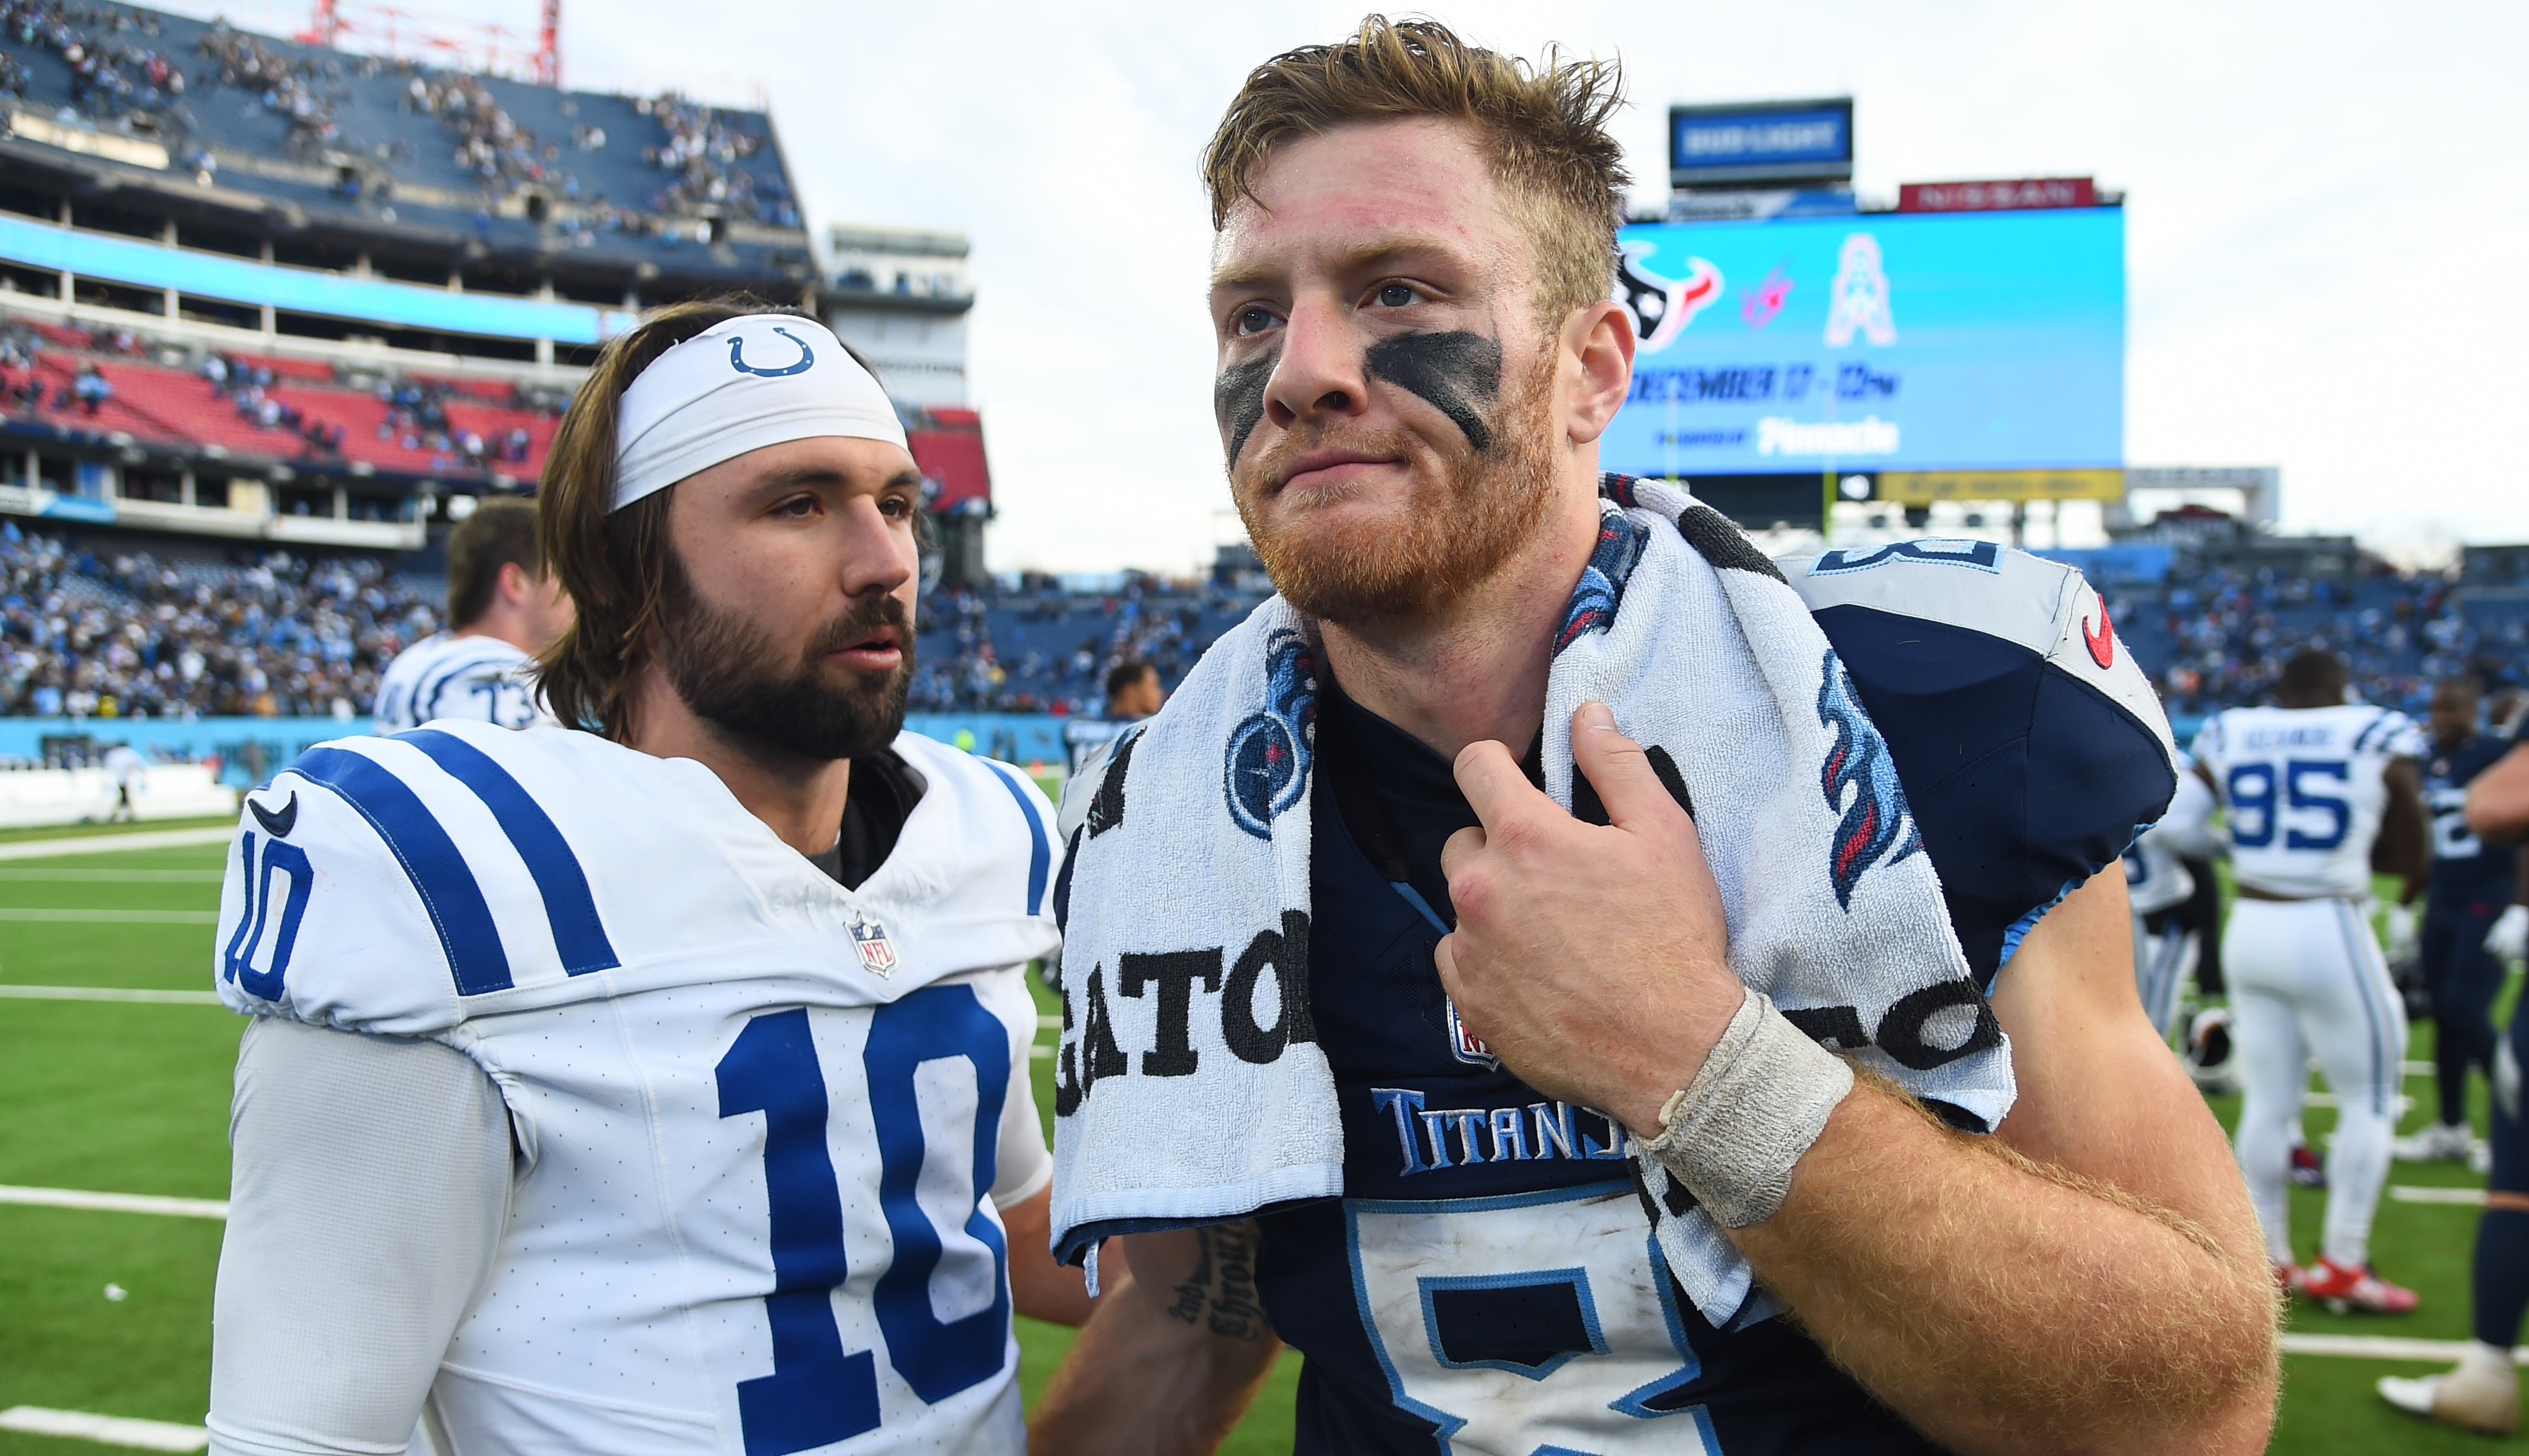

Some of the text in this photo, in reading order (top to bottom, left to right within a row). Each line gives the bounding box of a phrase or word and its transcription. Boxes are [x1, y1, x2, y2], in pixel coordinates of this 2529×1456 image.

[1918, 179, 2076, 209] NISSAN
[2229, 761, 2355, 850] 95
[223, 831, 314, 1003] 10
[860, 941, 893, 966] NFL
[714, 984, 1012, 1456] 10
[1343, 1180, 1724, 1456] 8
